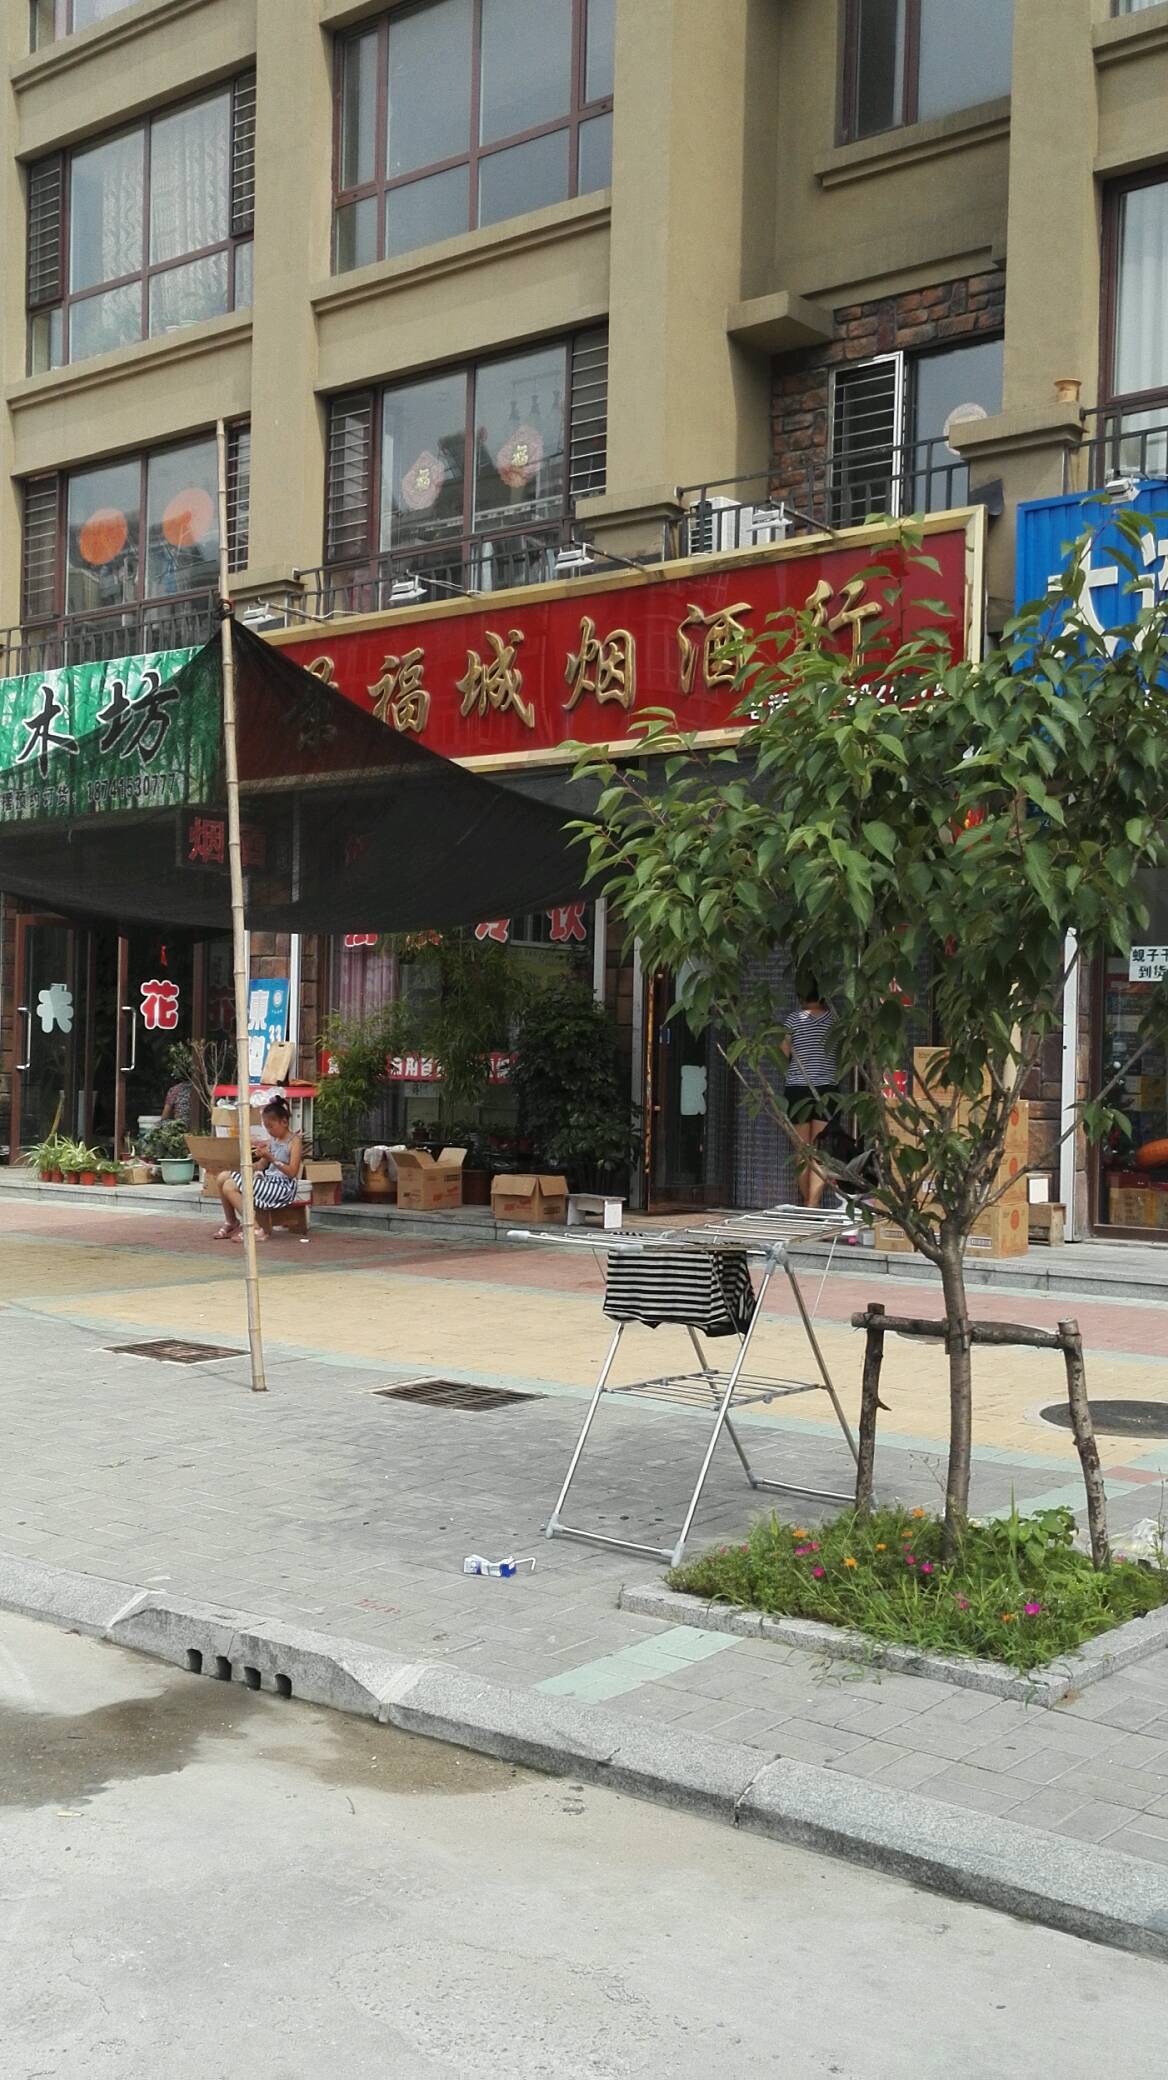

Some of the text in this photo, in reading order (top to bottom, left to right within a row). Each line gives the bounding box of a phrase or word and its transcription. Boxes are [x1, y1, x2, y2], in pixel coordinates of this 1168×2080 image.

[301, 579, 882, 733] 福城烟酒行
[17, 672, 180, 778] 木坊
[87, 773, 177, 802] 18741530777
[139, 979, 180, 1030] 花
